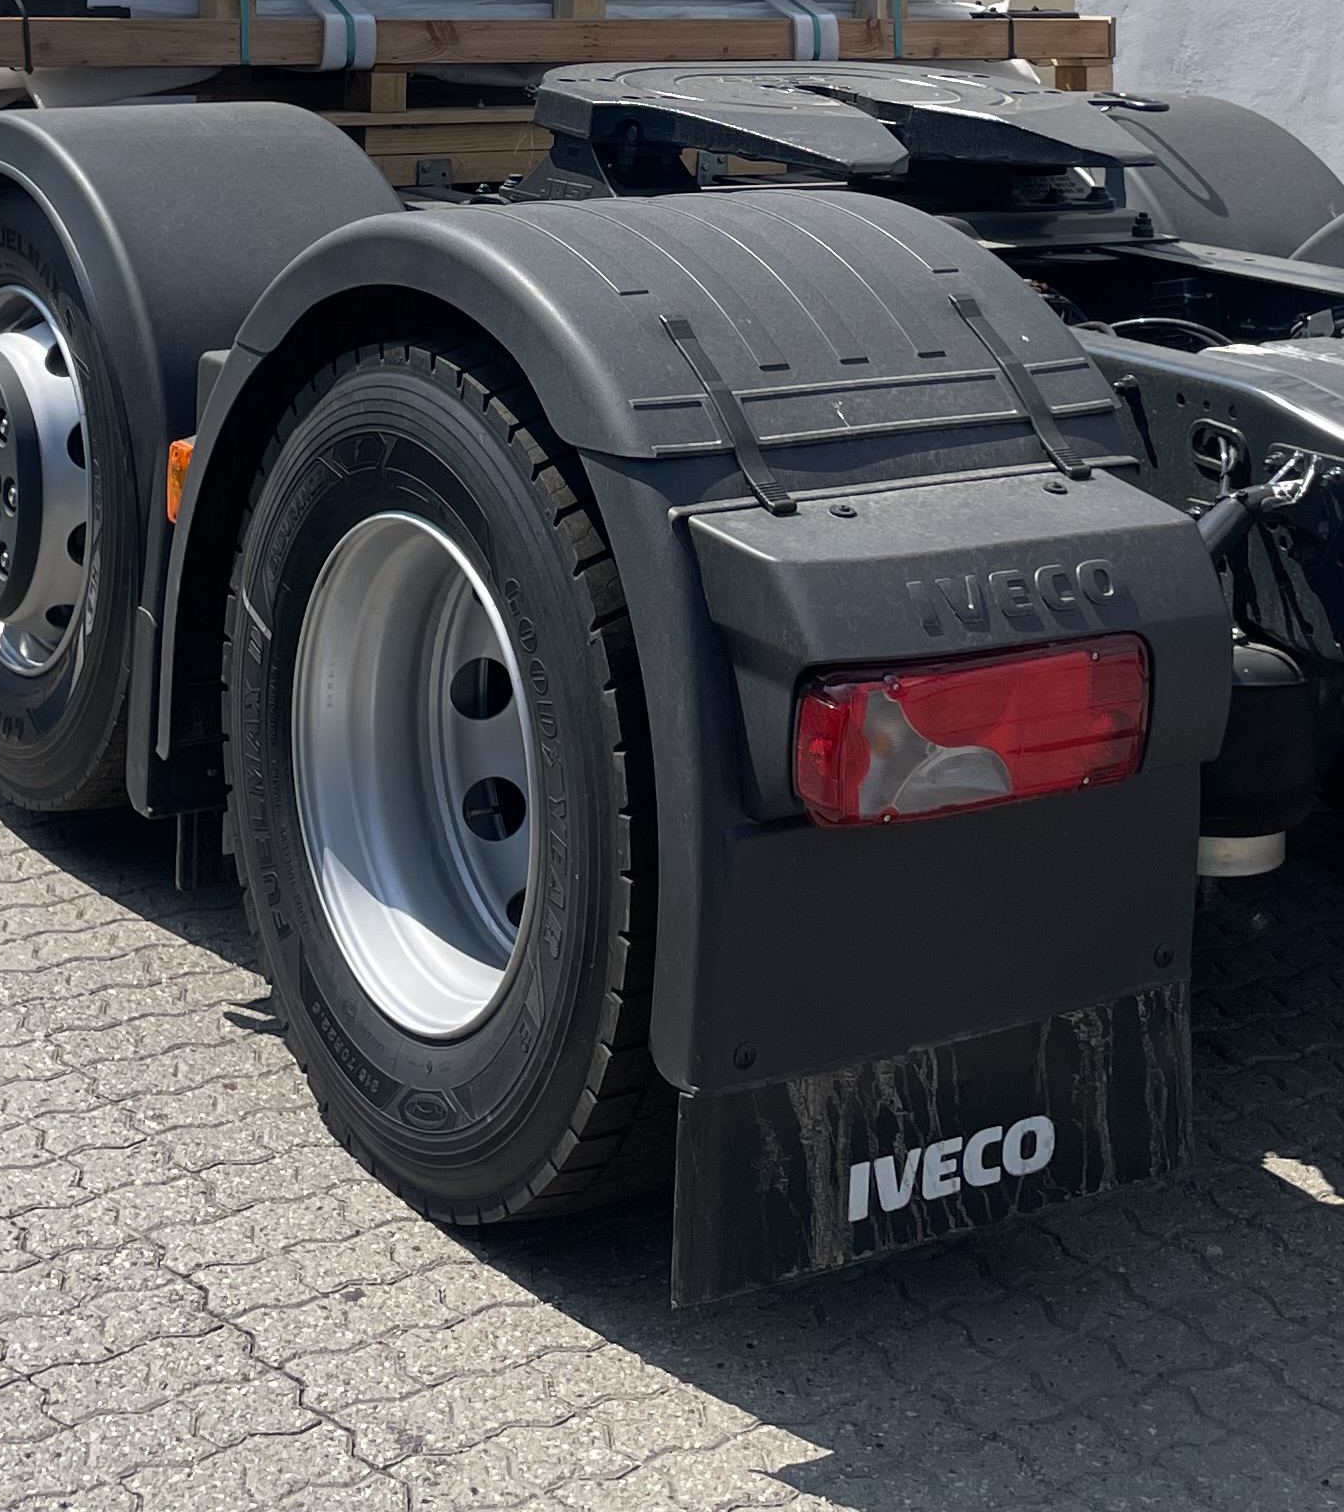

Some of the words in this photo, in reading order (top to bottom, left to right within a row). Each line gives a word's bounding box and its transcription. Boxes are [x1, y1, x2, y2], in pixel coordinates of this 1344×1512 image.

[906, 558, 1116, 630] IVECO
[243, 676, 294, 942] FUELMAX
[848, 1115, 1056, 1223] IVECO
